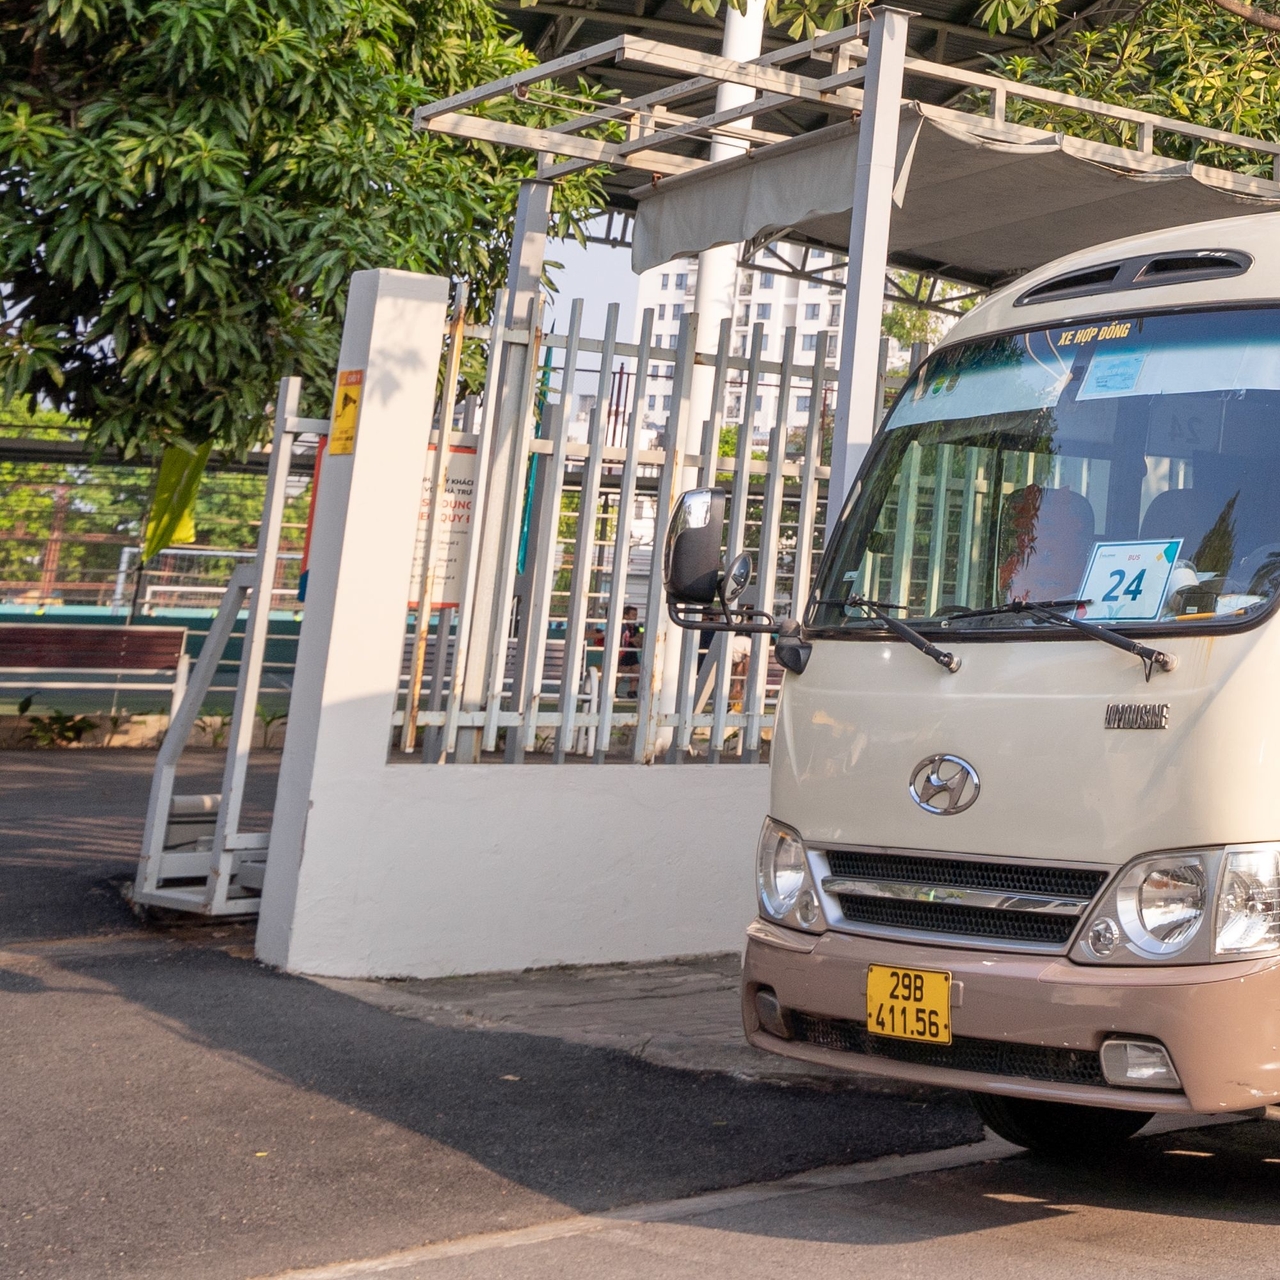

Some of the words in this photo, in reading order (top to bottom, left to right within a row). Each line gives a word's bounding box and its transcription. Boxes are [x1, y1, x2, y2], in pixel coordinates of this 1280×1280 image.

[1057, 330, 1075, 346] XE
[1074, 326, 1099, 346] HỢP
[1097, 320, 1131, 341] ĐỒNG
[1101, 568, 1147, 602] 24
[1104, 703, 1170, 729] LIMOUSINE
[889, 971, 924, 1002] 29B
[875, 1002, 939, 1038] 411.56
